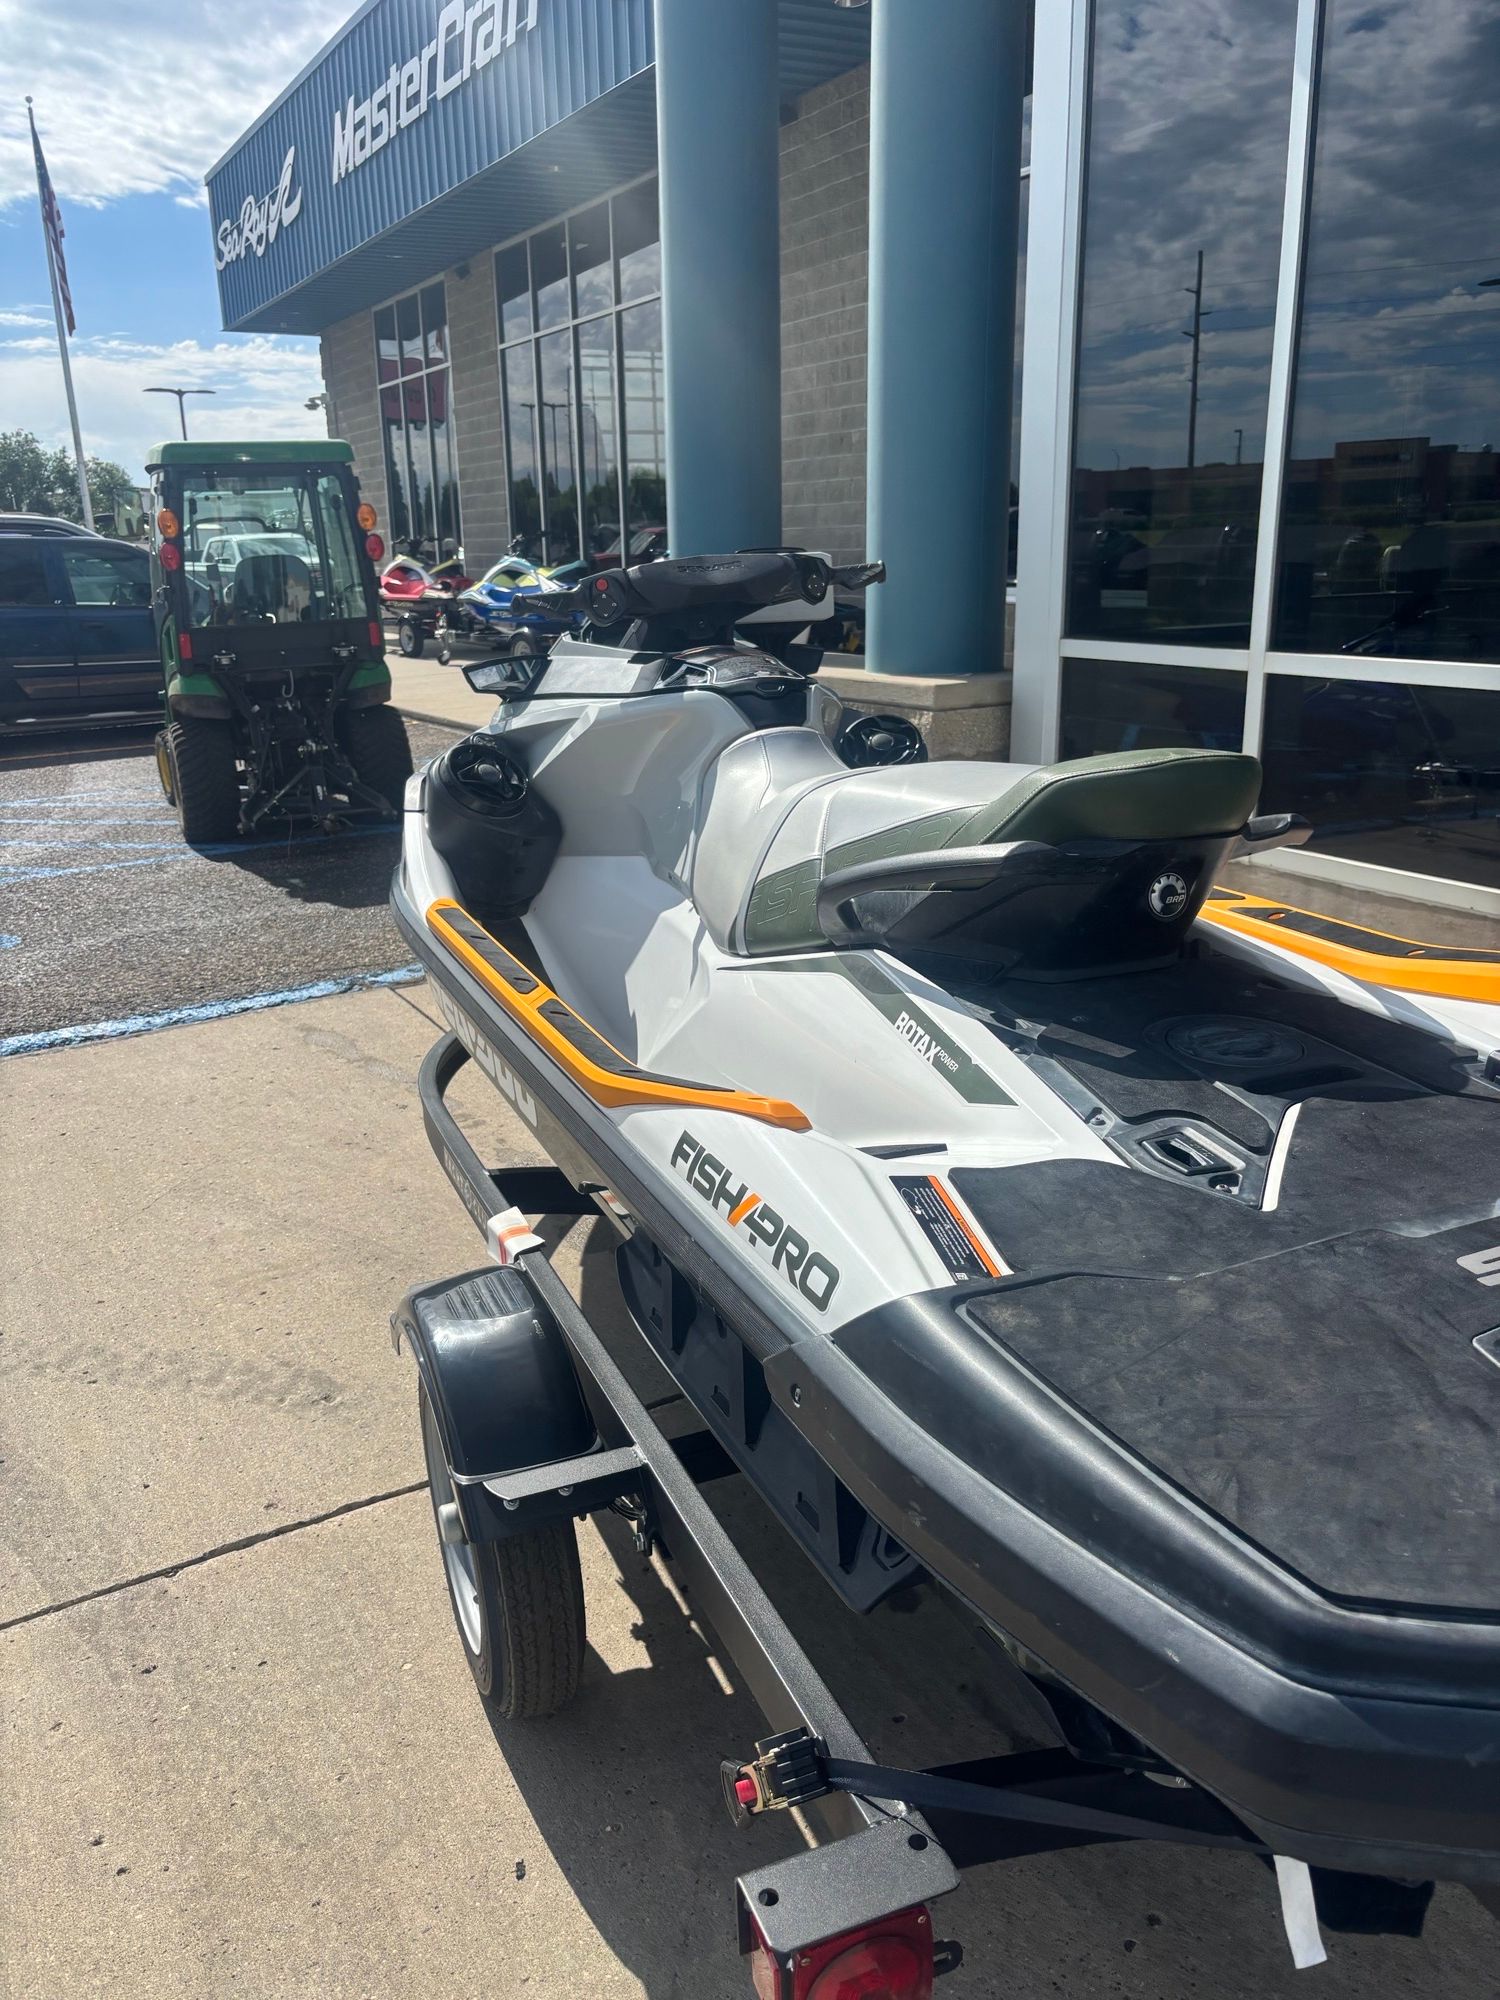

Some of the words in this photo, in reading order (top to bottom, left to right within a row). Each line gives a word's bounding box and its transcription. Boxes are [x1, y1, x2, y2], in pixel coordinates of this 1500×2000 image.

[1165, 894, 1185, 904] BRP
[894, 1010, 941, 1065] ROTAX
[936, 1049, 959, 1073] POWER
